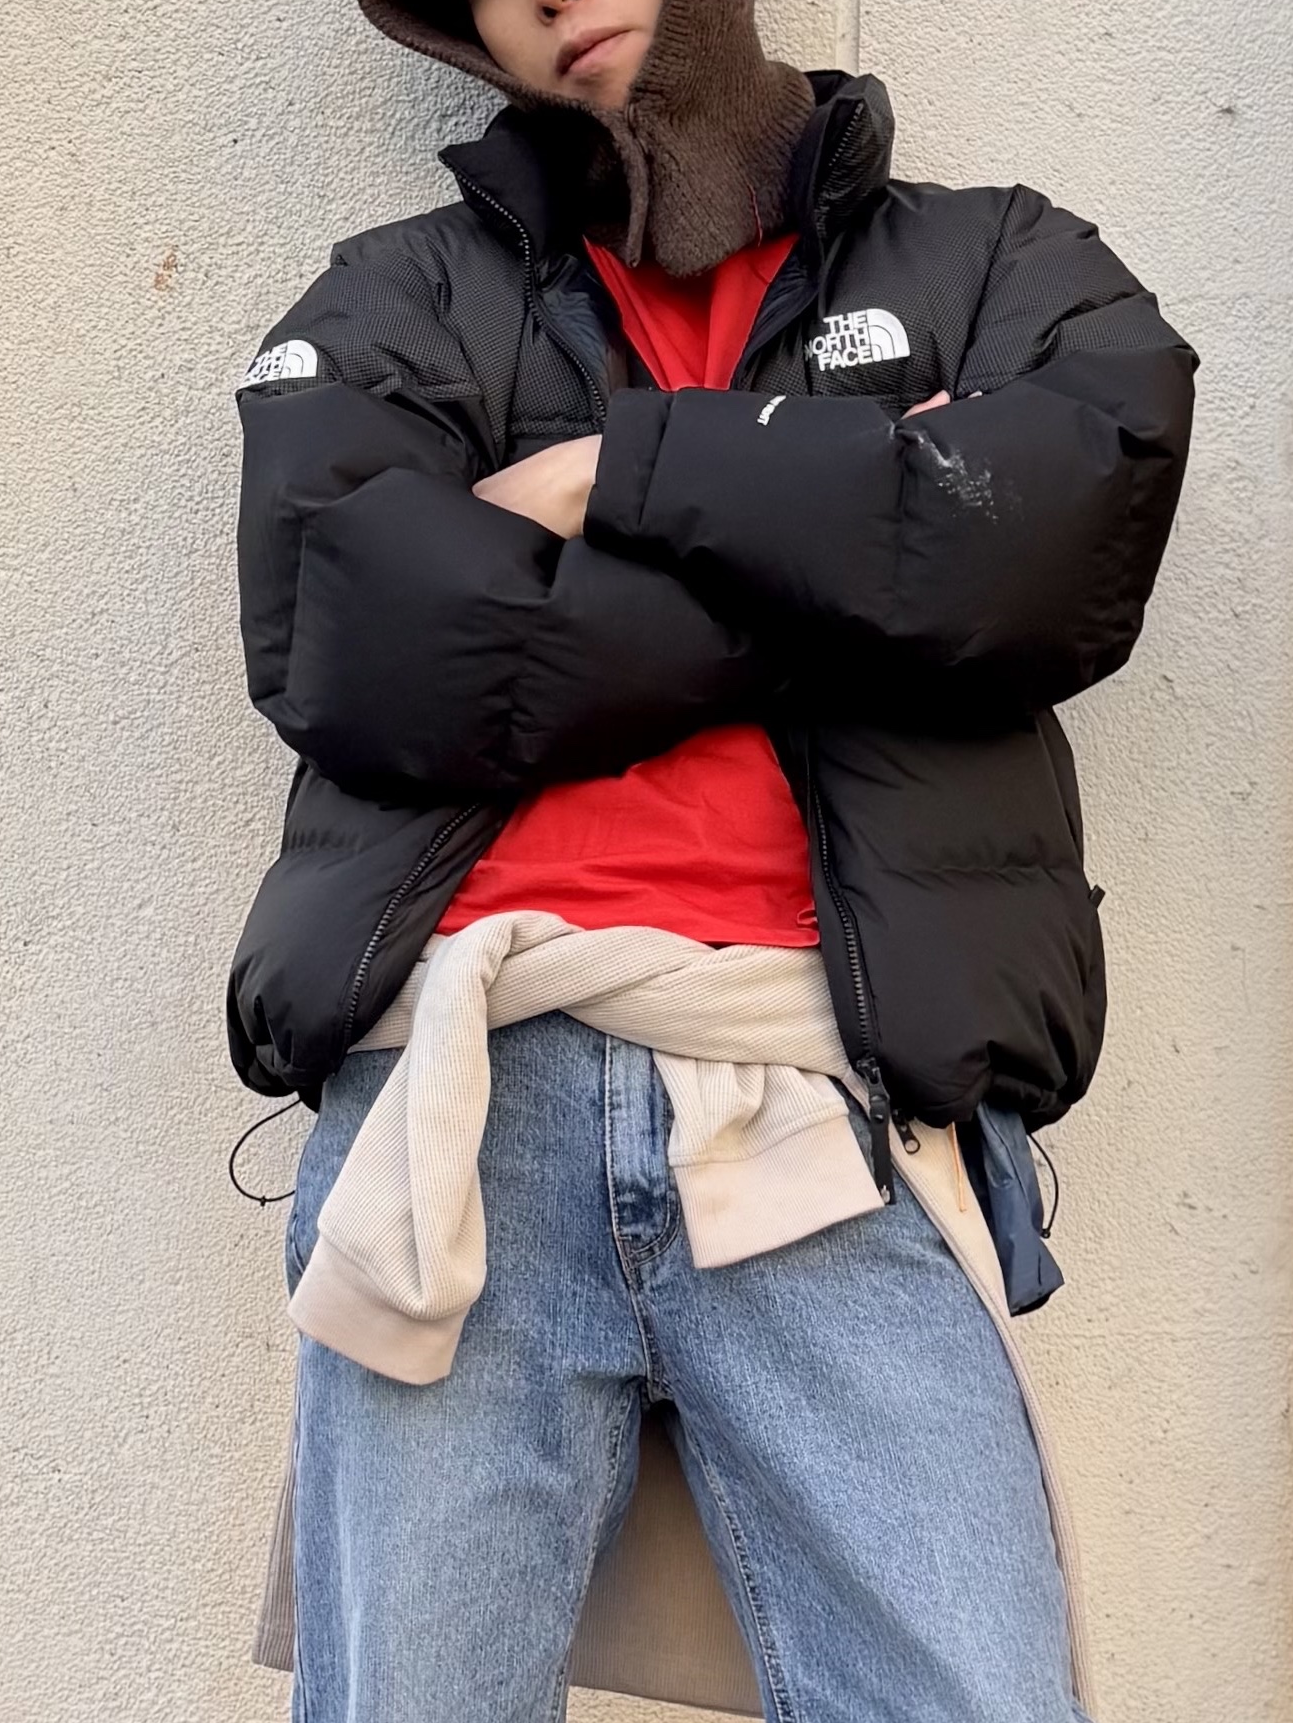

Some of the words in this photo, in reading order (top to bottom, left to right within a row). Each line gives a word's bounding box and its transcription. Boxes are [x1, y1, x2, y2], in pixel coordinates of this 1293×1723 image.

[822, 310, 868, 334] THE
[804, 326, 871, 362] NORTH
[817, 346, 873, 372] FACE
